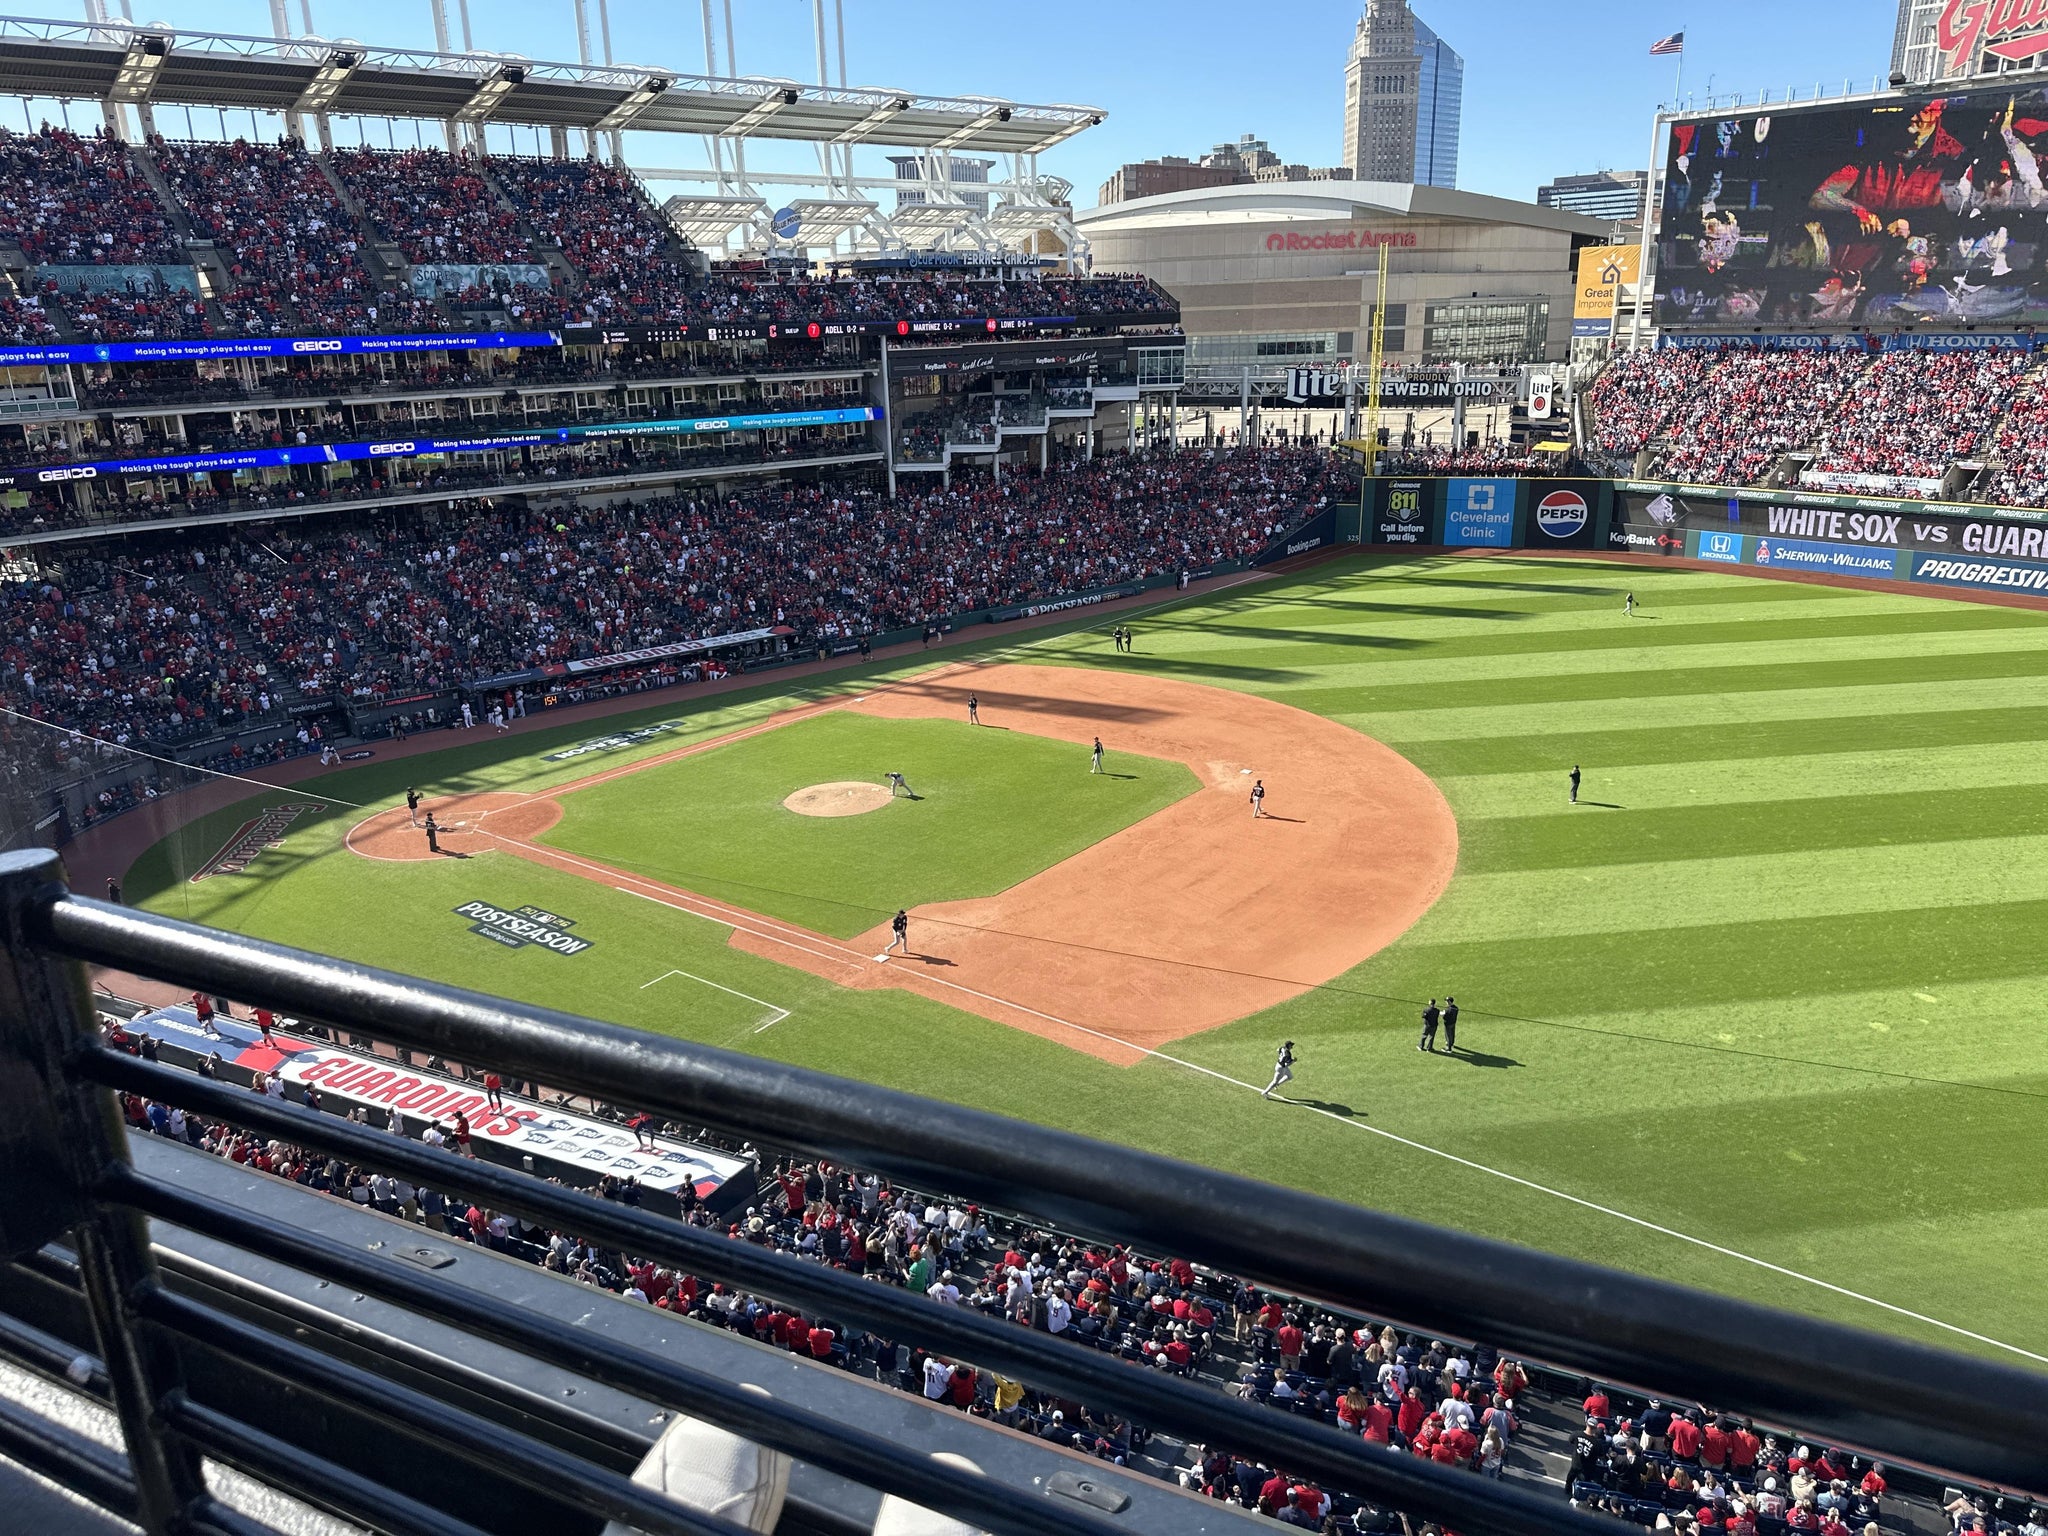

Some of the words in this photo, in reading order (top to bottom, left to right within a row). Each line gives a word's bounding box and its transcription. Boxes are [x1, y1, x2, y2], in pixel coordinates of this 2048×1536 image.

[1286, 230, 1357, 250] Rocket
[1359, 230, 1417, 248] Arena
[909, 252, 933, 268] BLUE
[934, 253, 959, 265] MOON
[962, 253, 1002, 265] TERRACE
[1005, 253, 1041, 265] GARDEN
[1584, 288, 1614, 298] Great
[825, 325, 844, 335] ADELL
[846, 325, 857, 334] 0-2
[913, 321, 941, 332] MARTÍNEZ
[943, 322, 953, 331] 0-2
[988, 321, 996, 329] 46
[1001, 320, 1015, 329] LOWE
[1017, 320, 1027, 328] 0-0
[292, 340, 343, 352] GEICO
[362, 340, 389, 348] Making
[403, 339, 424, 348] tough
[425, 338, 445, 346] plays
[1681, 336, 1753, 346] HONDA
[1928, 336, 2019, 348] HONDA
[135, 347, 166, 356] Making
[184, 346, 209, 354] tough
[211, 345, 233, 354] plays
[235, 344, 251, 352] feel
[0, 353, 25, 361] plays
[1035, 356, 1056, 364] KeyBank
[1081, 351, 1098, 363] Coast
[924, 362, 947, 371] KeyBank
[976, 357, 994, 368] Coast
[1406, 373, 1449, 382] PROUDLY
[1284, 367, 1341, 404] Lite
[1364, 382, 1430, 397] BREWED
[1433, 382, 1448, 397] IN
[1453, 382, 1492, 397] OHIO
[1532, 382, 1551, 395] Lite
[694, 420, 729, 430] GEICO
[742, 419, 761, 427] Making
[772, 418, 786, 426] tough
[812, 415, 824, 423] easy
[585, 429, 606, 437] Making
[621, 427, 636, 436] tough
[637, 426, 653, 434] plays
[433, 440, 458, 448] Making
[472, 438, 491, 447] tough
[492, 436, 511, 445] plays
[525, 434, 541, 442] easy
[369, 441, 415, 455] GEICO
[120, 464, 152, 473] Making
[170, 461, 194, 470] tough
[196, 459, 219, 468] plays
[238, 456, 257, 465] easy
[38, 466, 97, 482] GEICO
[1626, 483, 1663, 491] PROGRESSIVE
[1679, 487, 1718, 495] PROGRESSIVE
[1391, 491, 1417, 510] 811
[1735, 490, 1776, 499] PROGRESSIVE
[1794, 495, 1838, 504] PROGRESSIVE
[1856, 499, 1902, 509] PROGRESSIVE
[1922, 504, 1972, 514] PROGRESSIVE
[1450, 511, 1510, 523] Cleveland
[1540, 508, 1584, 520] PEPSI
[1993, 509, 2046, 519] PROGRESSIVE
[1380, 523, 1396, 533] Call
[1398, 523, 1425, 533] before
[1461, 526, 1496, 538] Clinic
[1768, 506, 1843, 539] WHITE
[1847, 512, 1902, 544] SOX
[1962, 523, 2048, 559] GUAR
[1346, 534, 1360, 542] 325
[1386, 534, 1401, 543] you
[1402, 533, 1417, 542] dig.
[1609, 531, 1657, 546] KeyBank
[1286, 537, 1321, 555] Booking.com
[1701, 551, 1737, 561] HONDA
[1916, 559, 2048, 590] PROGRESSIV
[1039, 594, 1102, 614] POSTSEASON
[580, 640, 704, 668] CLEVELAND
[288, 700, 333, 714] Booking.com
[554, 724, 673, 759] POSTSEASON
[457, 902, 588, 954] POSTSEASON
[478, 927, 519, 946] Booking.com
[299, 1057, 543, 1137] GUARDIANS
[1576, 1442, 1591, 1457] 35
